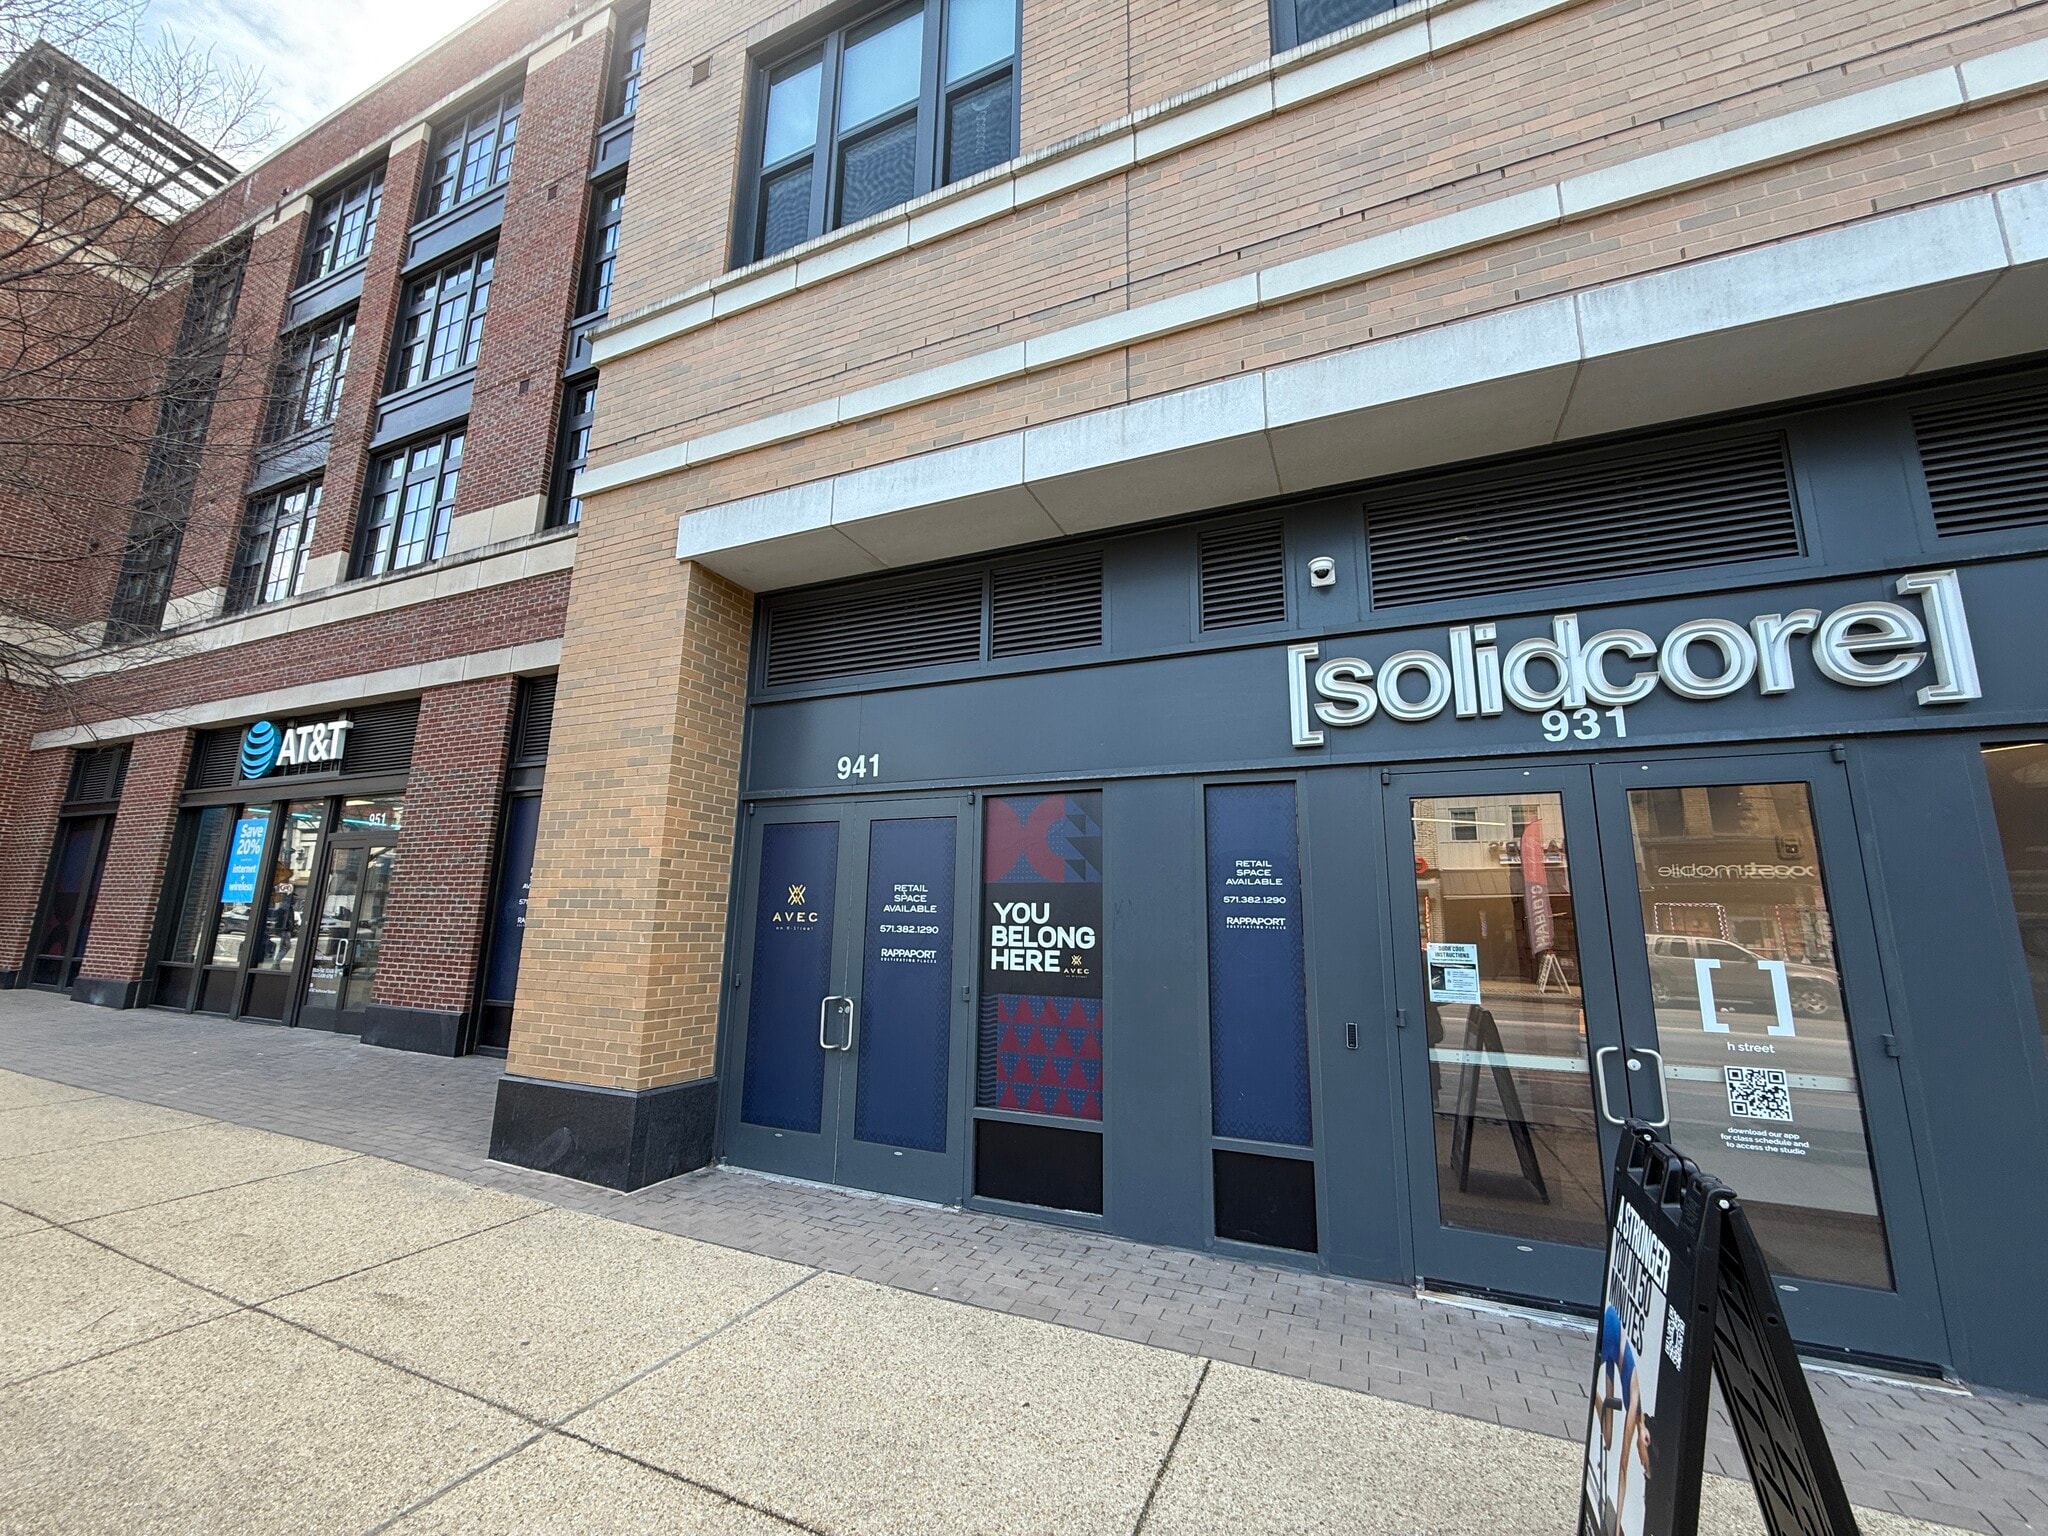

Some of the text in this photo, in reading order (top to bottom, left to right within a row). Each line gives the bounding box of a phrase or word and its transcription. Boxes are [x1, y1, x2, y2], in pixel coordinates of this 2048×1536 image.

[1542, 705, 1626, 742] 931
[276, 720, 353, 766] AT&T
[837, 753, 879, 780] 941
[369, 813, 386, 826] 951
[240, 824, 264, 838] Save
[236, 839, 261, 855] 20%
[232, 864, 257, 873] internet
[229, 882, 253, 891] wireless
[894, 884, 928, 892] RETAIL
[1225, 878, 1283, 886] AVAILABLE
[894, 894, 927, 902] SPACE
[1223, 896, 1287, 904] 571.382.1290
[883, 905, 937, 913] AVAILABLE
[993, 902, 1050, 924] YOU
[772, 911, 818, 922] AVEC
[1226, 917, 1286, 926] RAPPAPORT
[880, 925, 939, 934] 571.382.1290
[991, 925, 1096, 949] BELONG
[881, 948, 937, 959] RAPPAPORT
[990, 948, 1060, 973] HERE
[1726, 1041, 1775, 1054] h street
[1727, 1126, 1800, 1140] download our app
[1733, 1134, 1754, 1143] class
[1754, 1136, 1792, 1147] schedule
[1793, 1140, 1810, 1148] and
[1736, 1143, 1764, 1151] access
[1765, 1144, 1778, 1153] the
[1780, 1146, 1806, 1155] studio
[1616, 1195, 1671, 1295] A STRONGER
[1614, 1230, 1652, 1318] YOU IN 50
[1609, 1268, 1645, 1357] MINUTES
